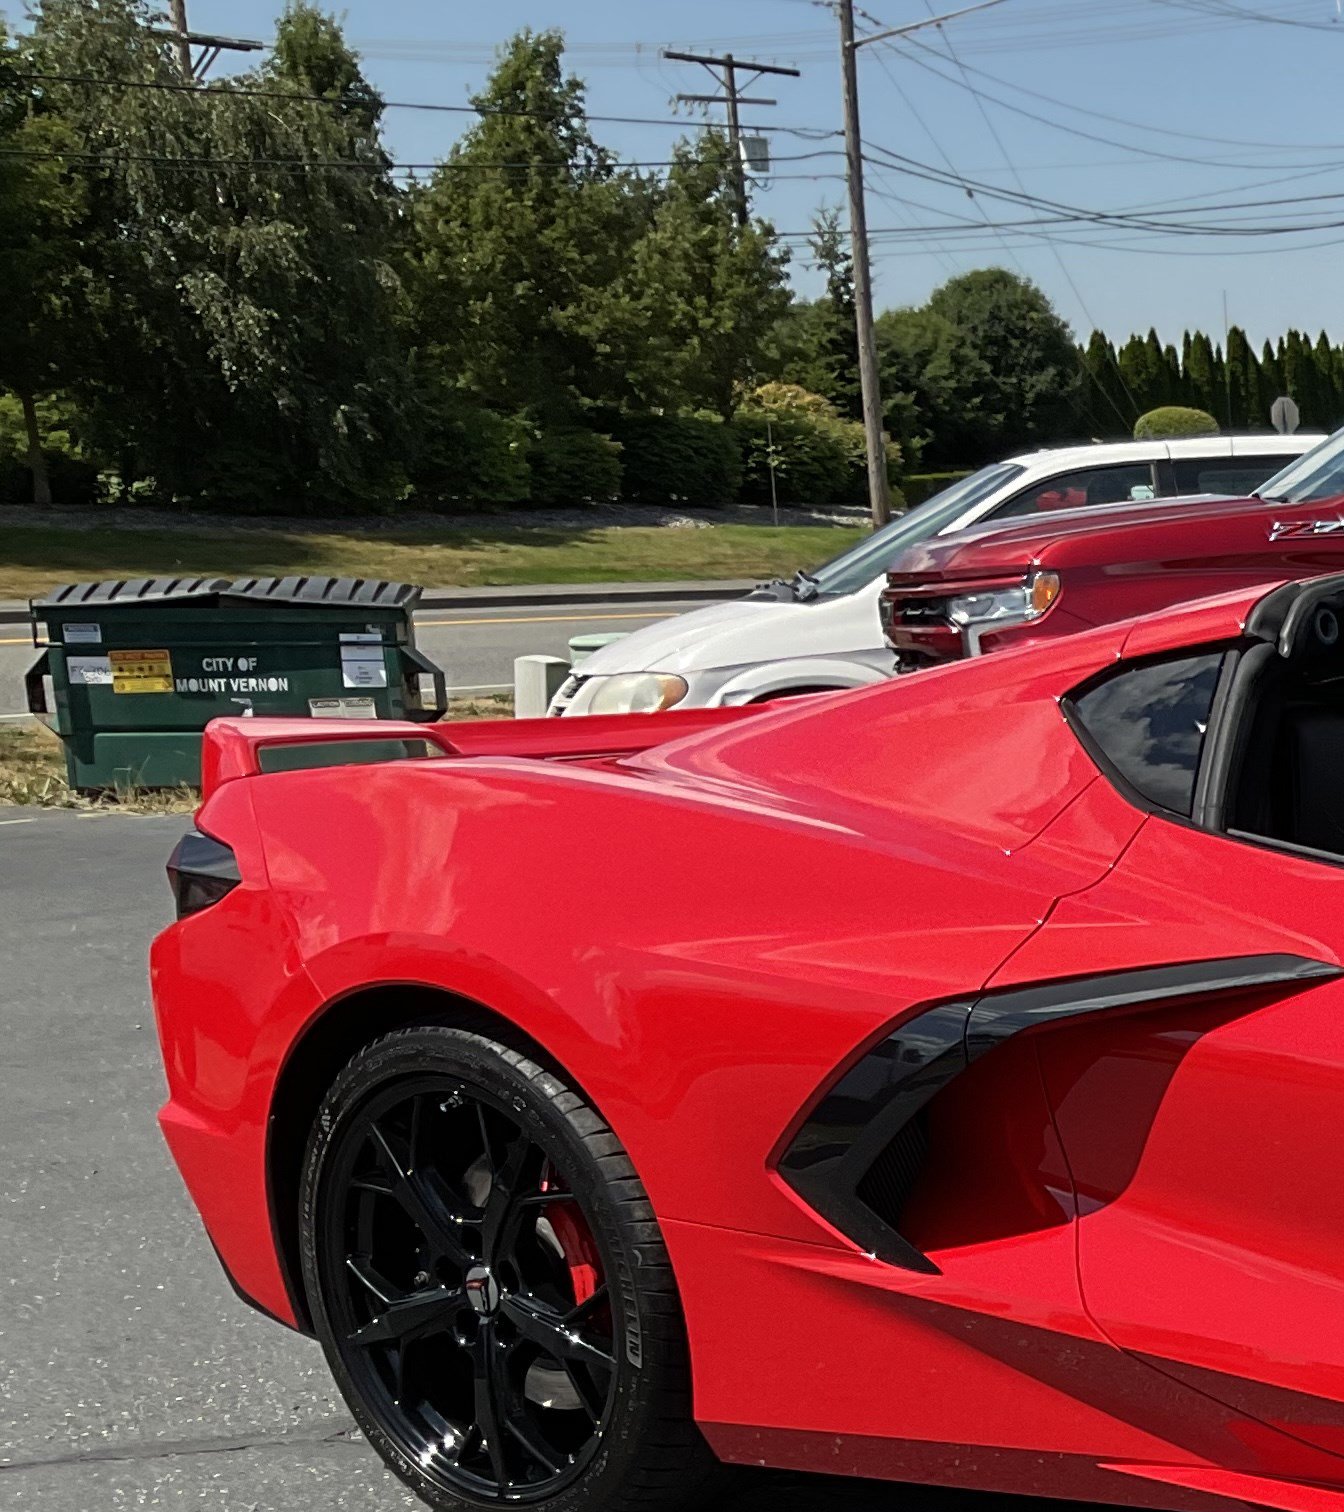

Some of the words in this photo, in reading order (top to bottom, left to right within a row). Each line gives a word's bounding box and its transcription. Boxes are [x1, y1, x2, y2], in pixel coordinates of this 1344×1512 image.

[202, 658, 234, 672] CITY
[237, 657, 257, 672] OF
[176, 678, 227, 693] MOUNT
[230, 677, 289, 692] VERNON
